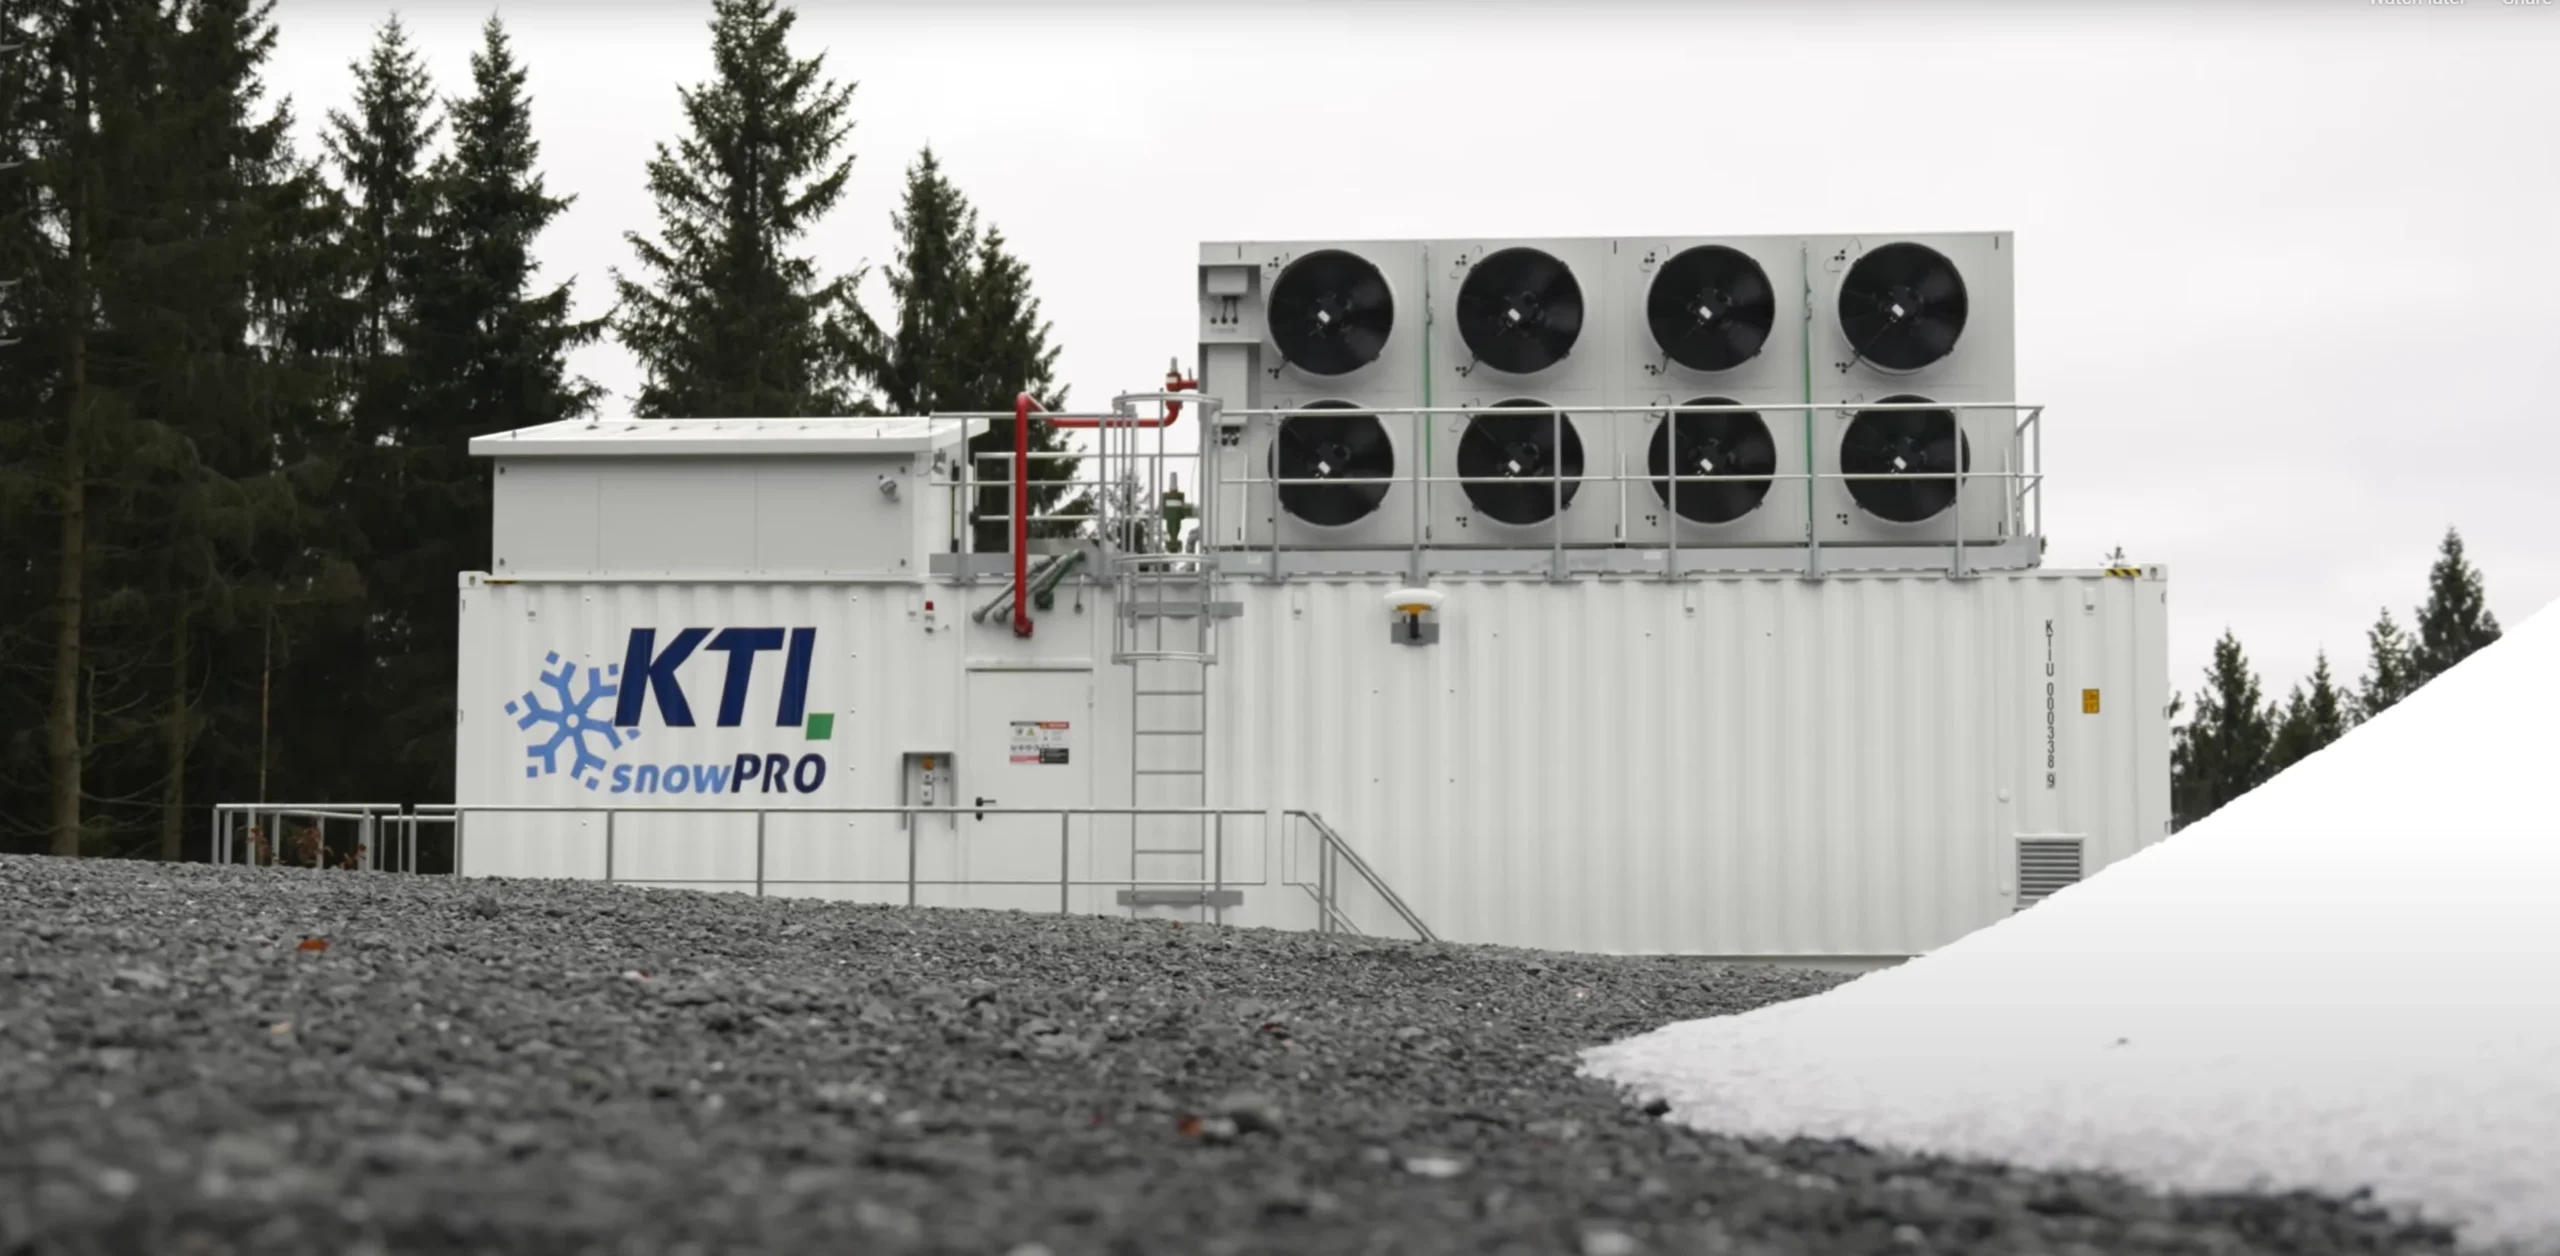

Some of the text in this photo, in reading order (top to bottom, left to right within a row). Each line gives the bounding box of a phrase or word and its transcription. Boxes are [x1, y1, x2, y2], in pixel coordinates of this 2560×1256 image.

[2045, 619, 2055, 677] KTIU
[2046, 682, 2055, 769] 000338
[610, 753, 827, 794] snowPRO
